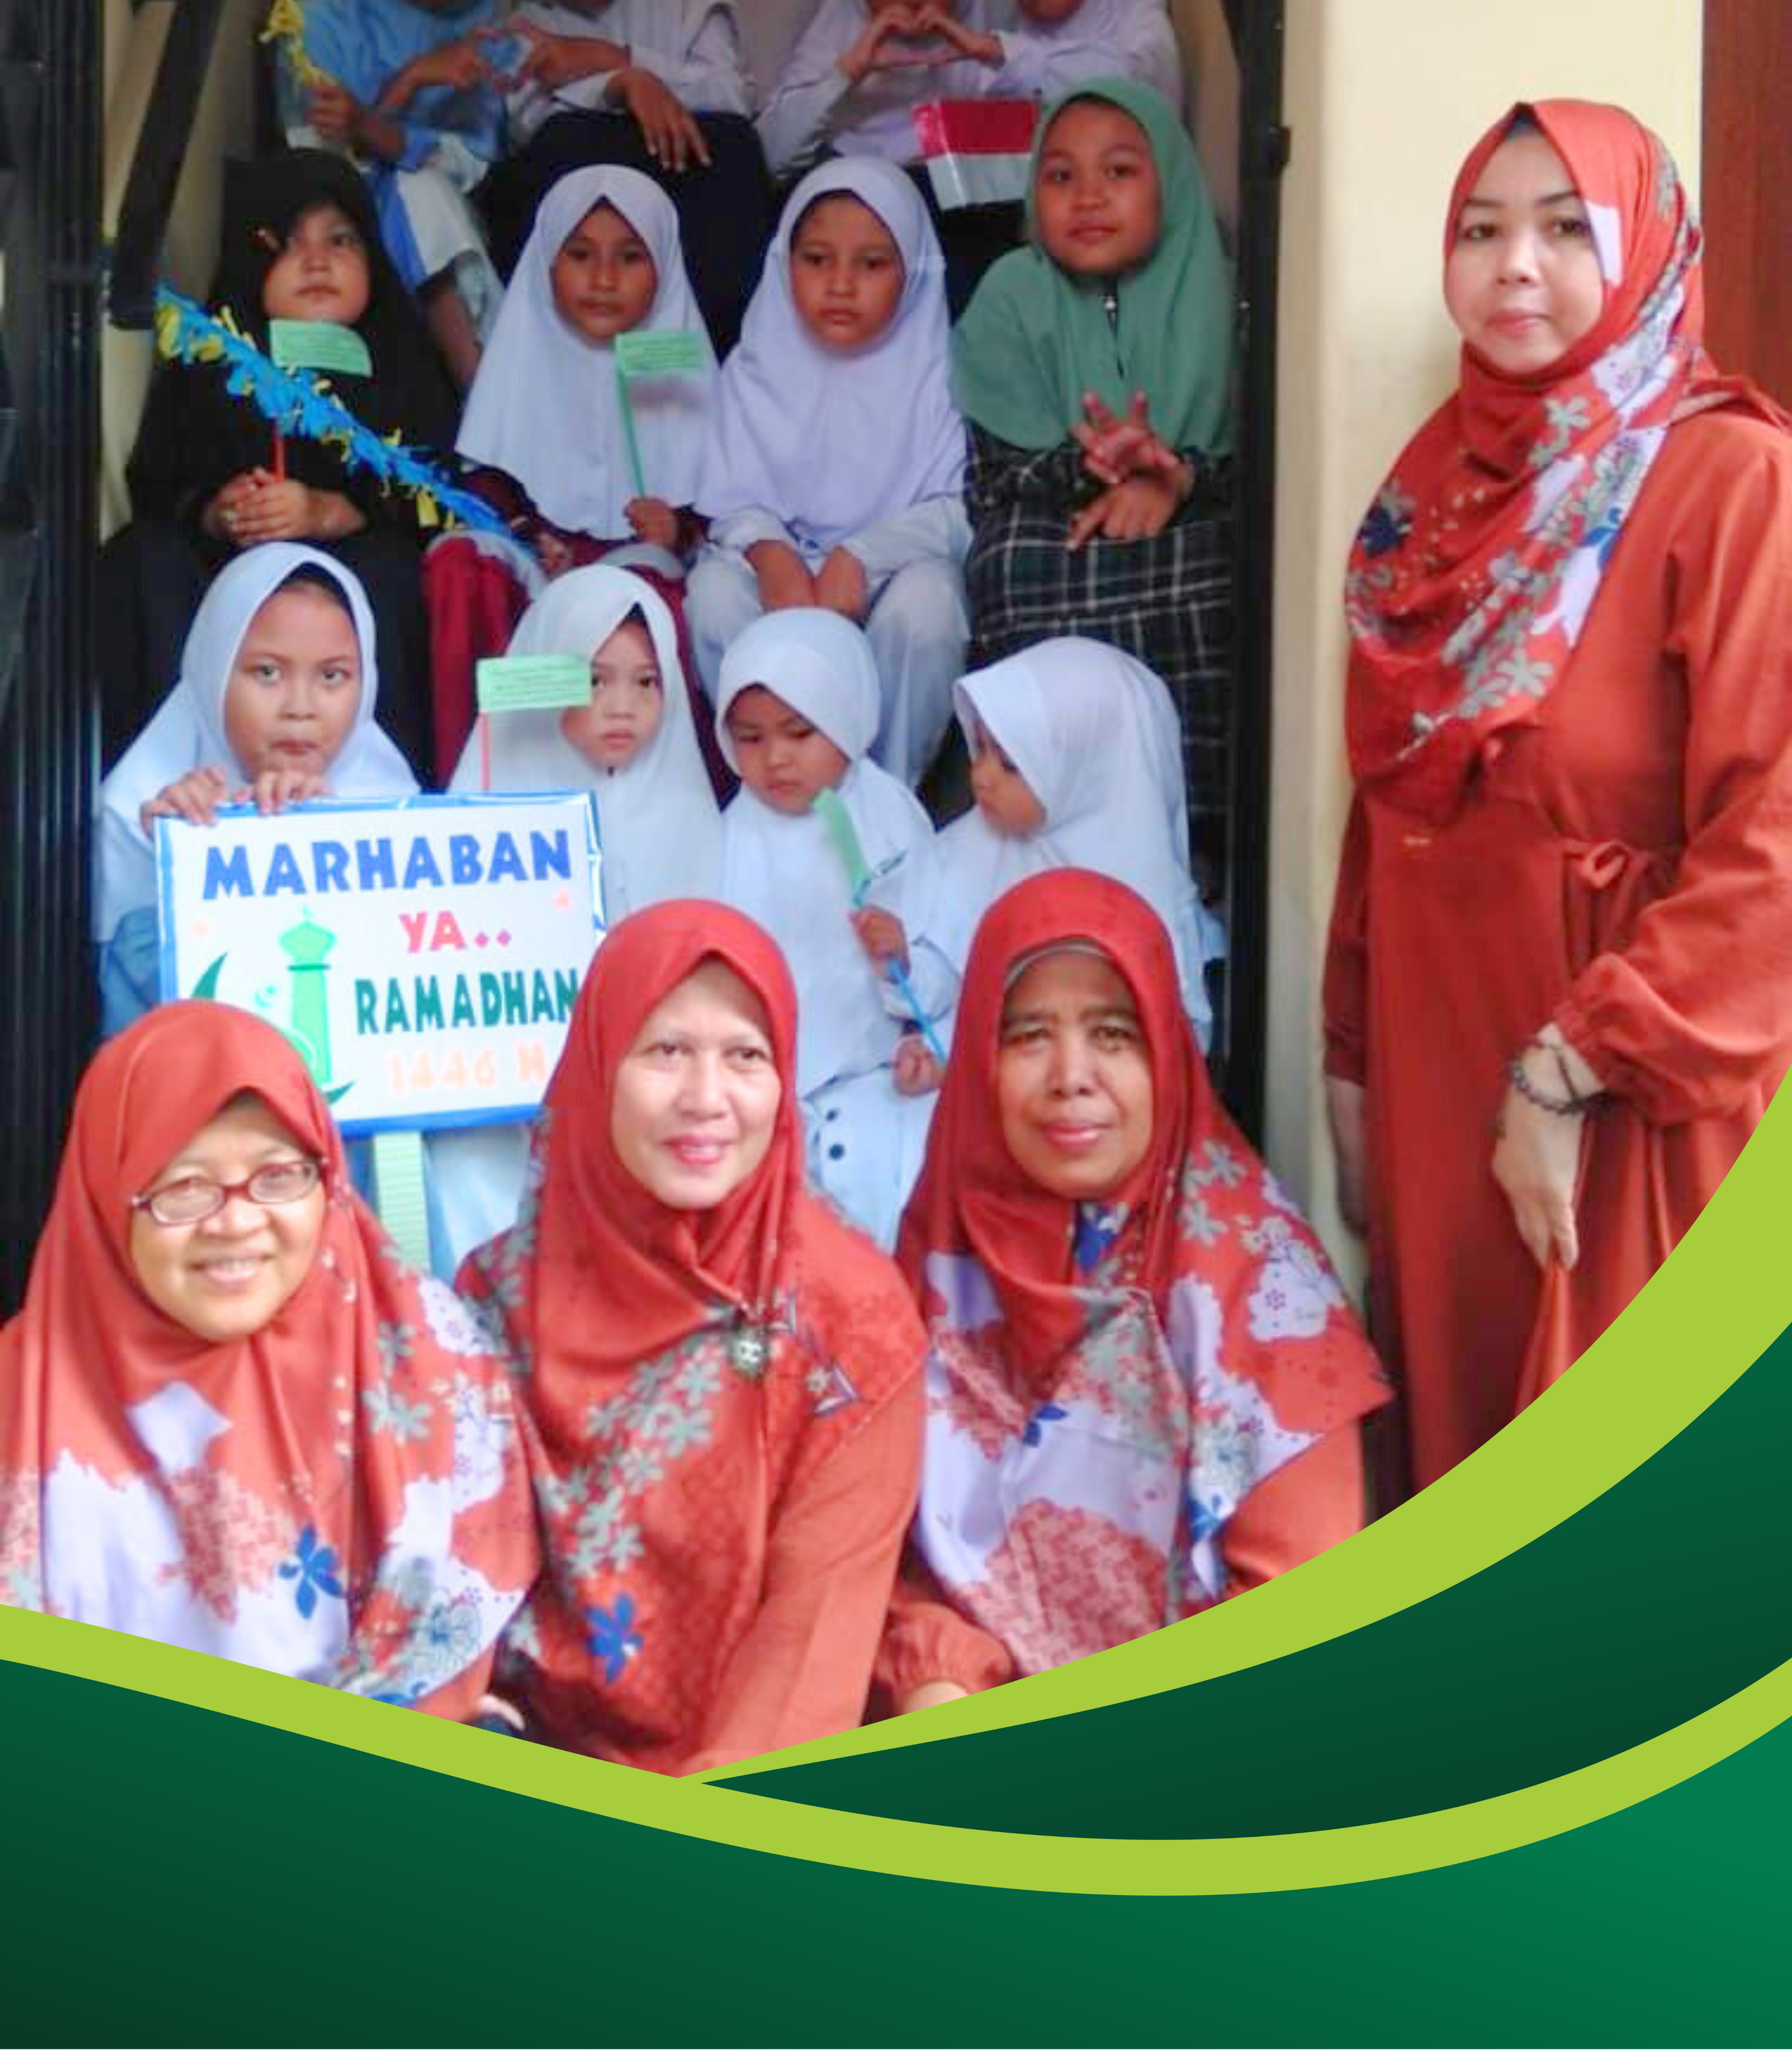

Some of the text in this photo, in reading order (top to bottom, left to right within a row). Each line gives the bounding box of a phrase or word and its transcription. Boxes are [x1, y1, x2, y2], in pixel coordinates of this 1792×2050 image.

[202, 829, 572, 900] MARHABAN
[355, 968, 578, 1035] RAMADHAN
[392, 1049, 495, 1091] 1446
